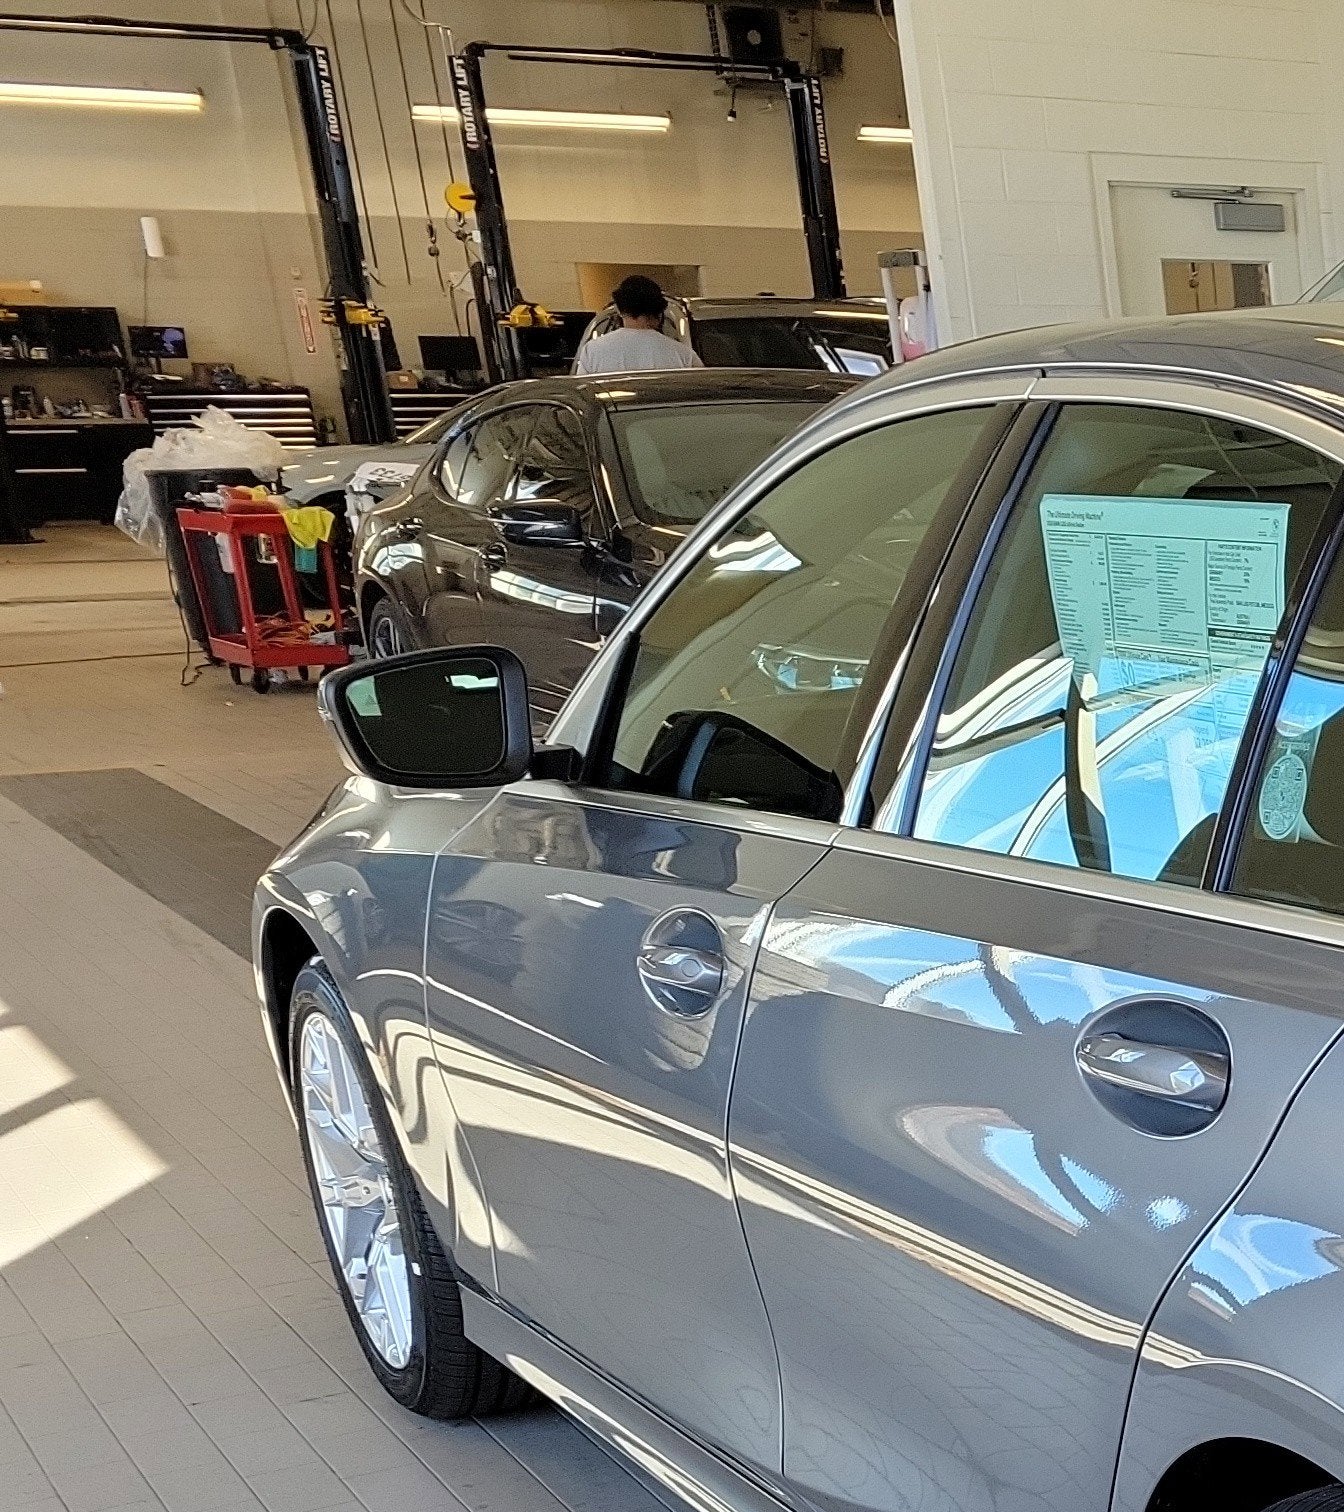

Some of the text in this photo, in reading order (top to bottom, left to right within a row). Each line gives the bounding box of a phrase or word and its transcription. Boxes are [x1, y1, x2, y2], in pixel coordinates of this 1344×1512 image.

[314, 47, 341, 135] ROTARY LIFT
[452, 56, 478, 142] ROTARY LIFT
[810, 78, 828, 158] ROTARY LIFT
